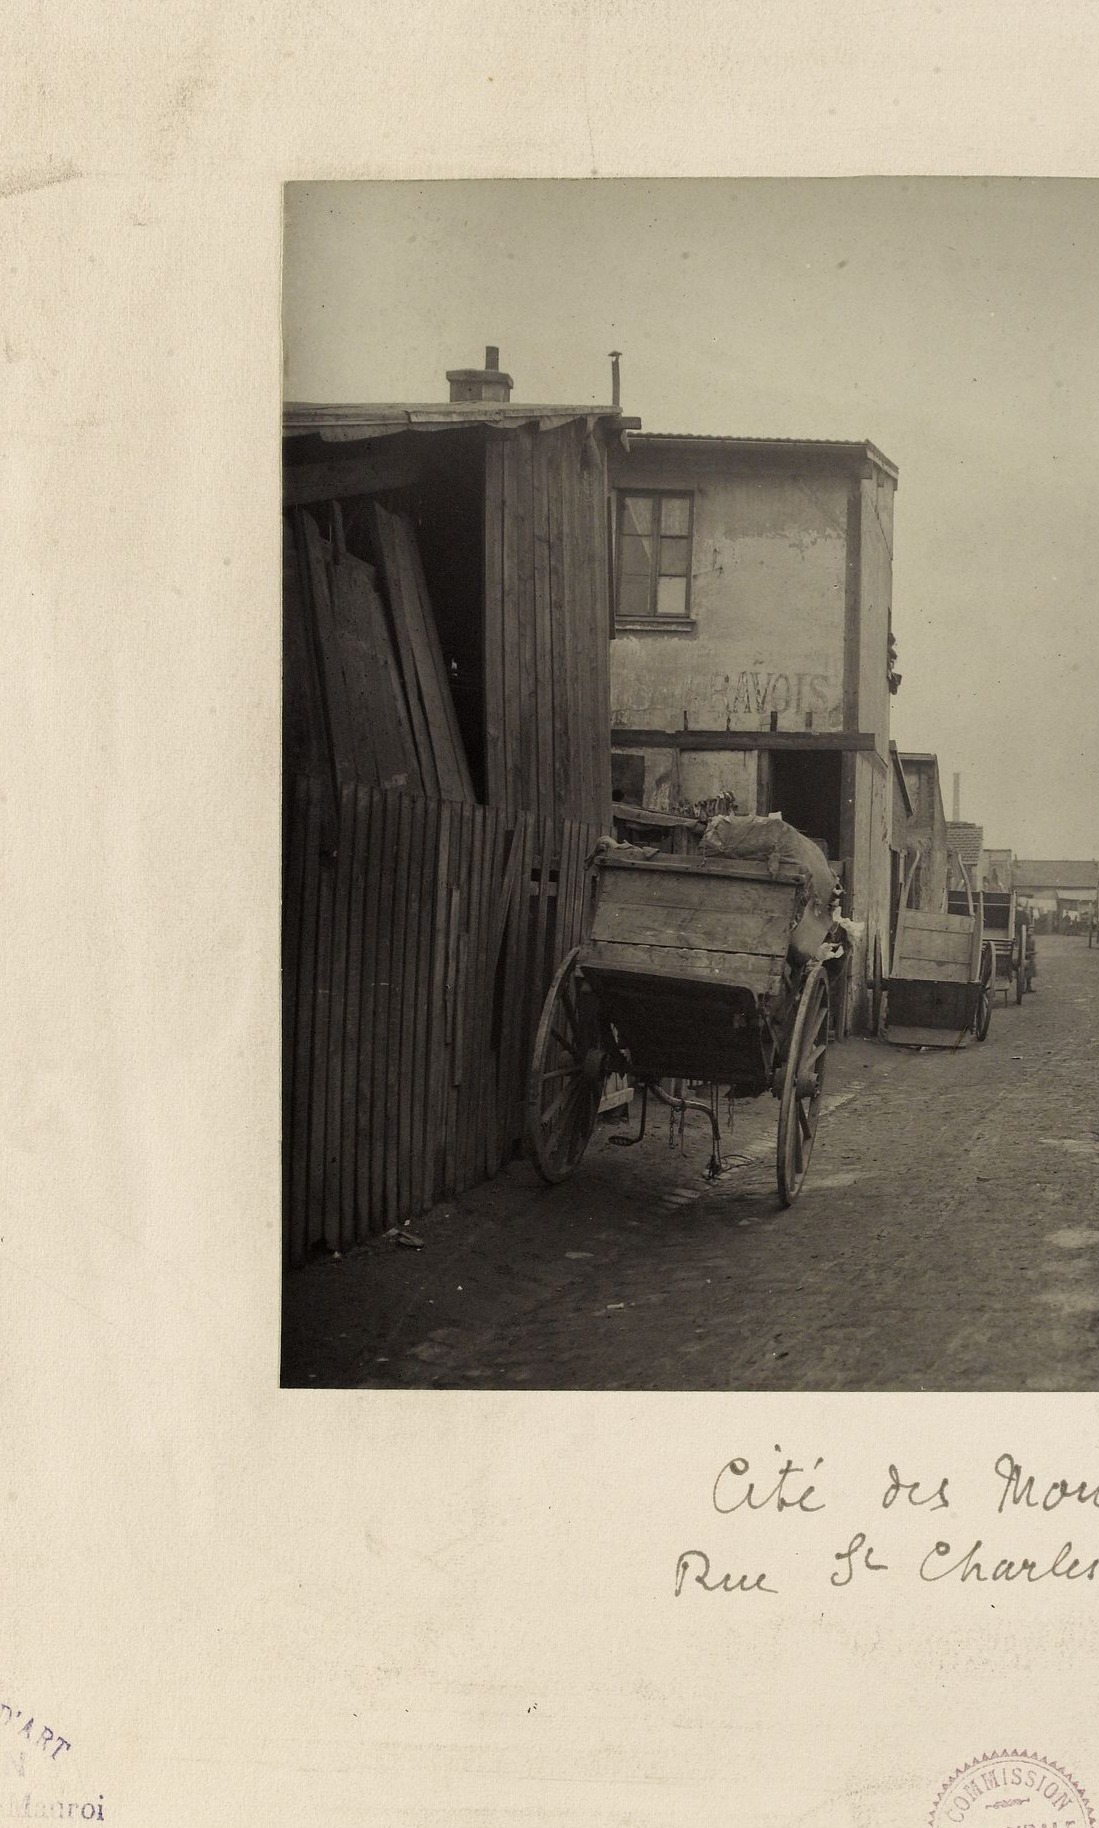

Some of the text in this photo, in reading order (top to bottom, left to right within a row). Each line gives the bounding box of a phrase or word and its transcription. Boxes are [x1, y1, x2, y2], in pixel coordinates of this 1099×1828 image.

[687, 670, 832, 714] RAVOIS
[713, 1444, 826, 1514] Cité
[882, 1463, 950, 1512] des
[674, 1550, 779, 1598] Rue
[945, 1767, 1074, 1823] COMMISSION
